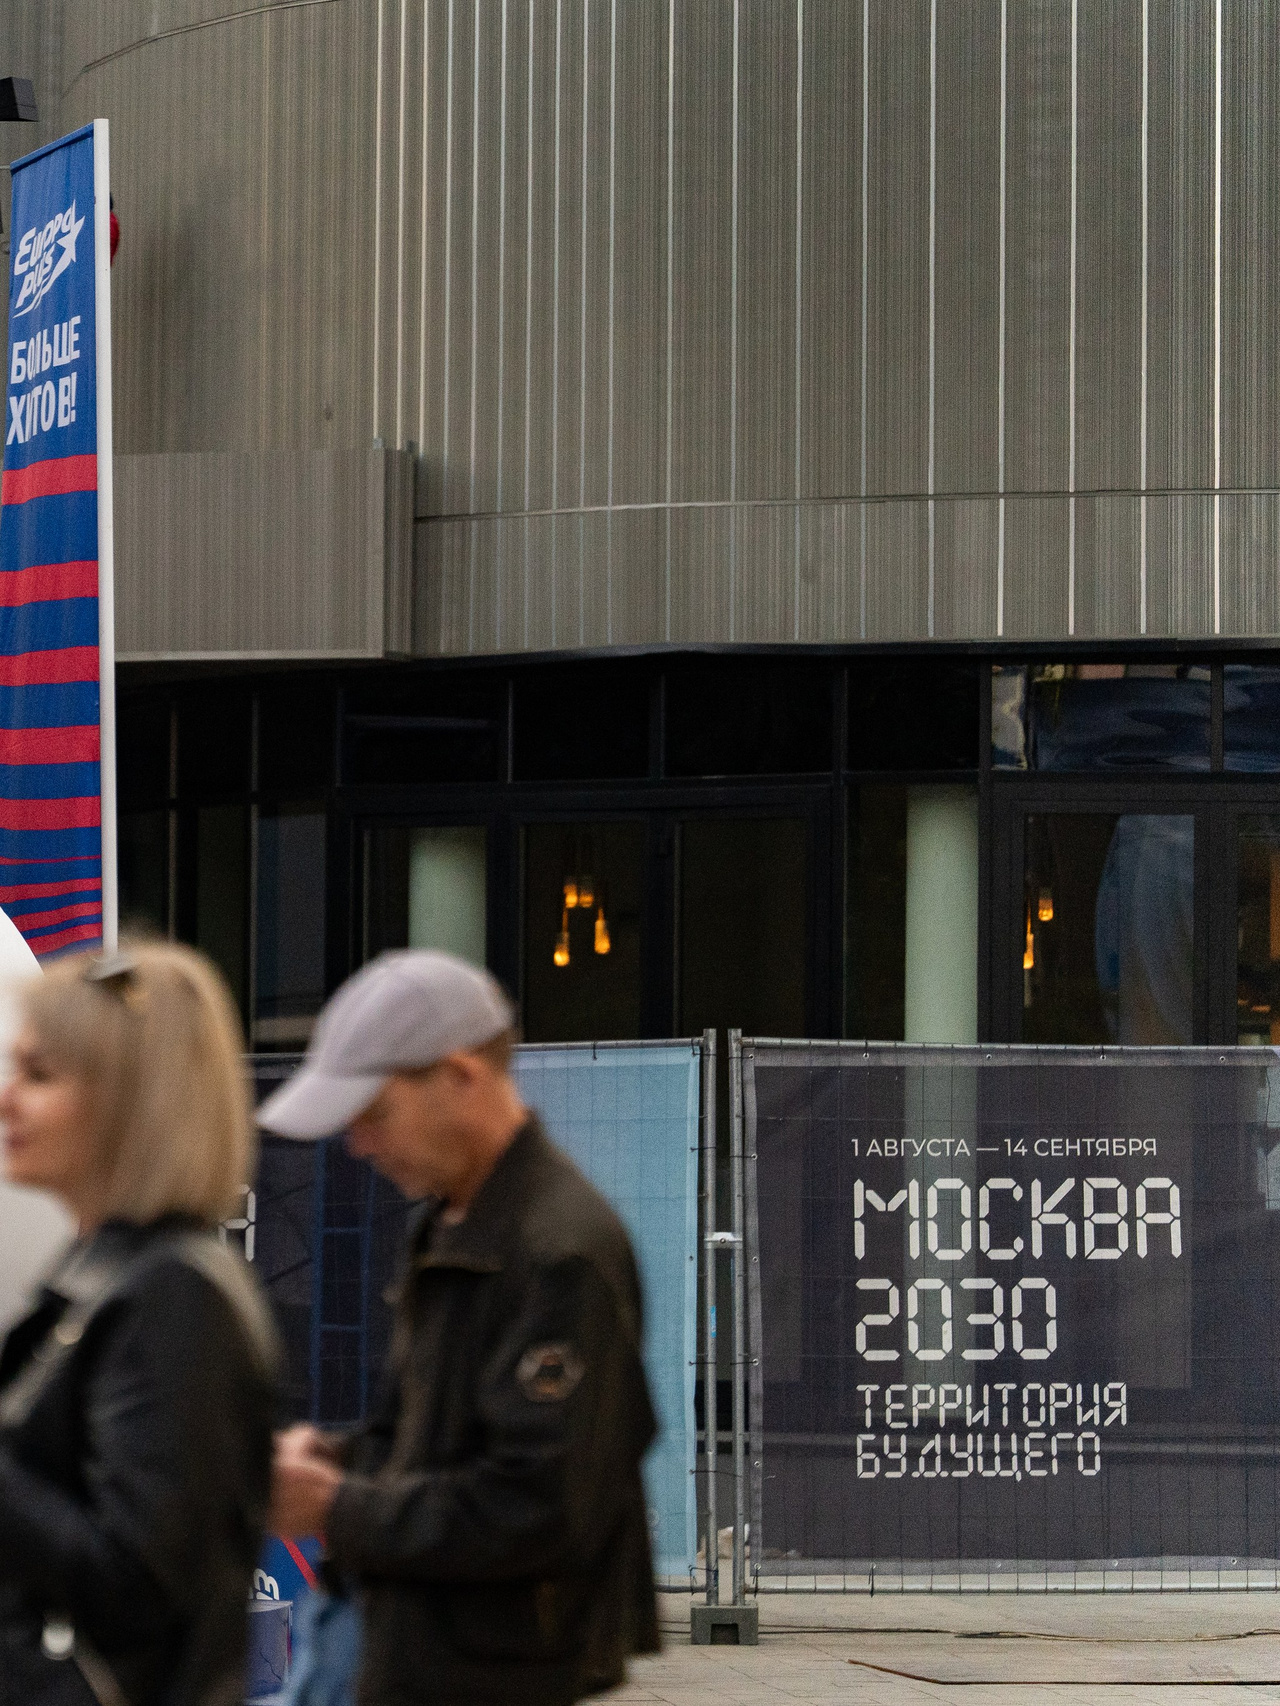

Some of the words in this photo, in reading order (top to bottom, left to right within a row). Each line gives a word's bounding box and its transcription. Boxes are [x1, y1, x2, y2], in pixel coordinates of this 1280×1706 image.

[851, 1138, 858, 1156] 1
[866, 1138, 971, 1157] АВГУСТА
[1004, 1138, 1028, 1157] 14
[1034, 1138, 1157, 1157] СЕНТЯБРЯ
[854, 1177, 1182, 1261] МОСКВА
[855, 1277, 1057, 1361] 2030
[856, 1382, 1127, 1428] ТЕРРИТОРИЯ
[856, 1431, 1101, 1481] БУДУЩЕГО
